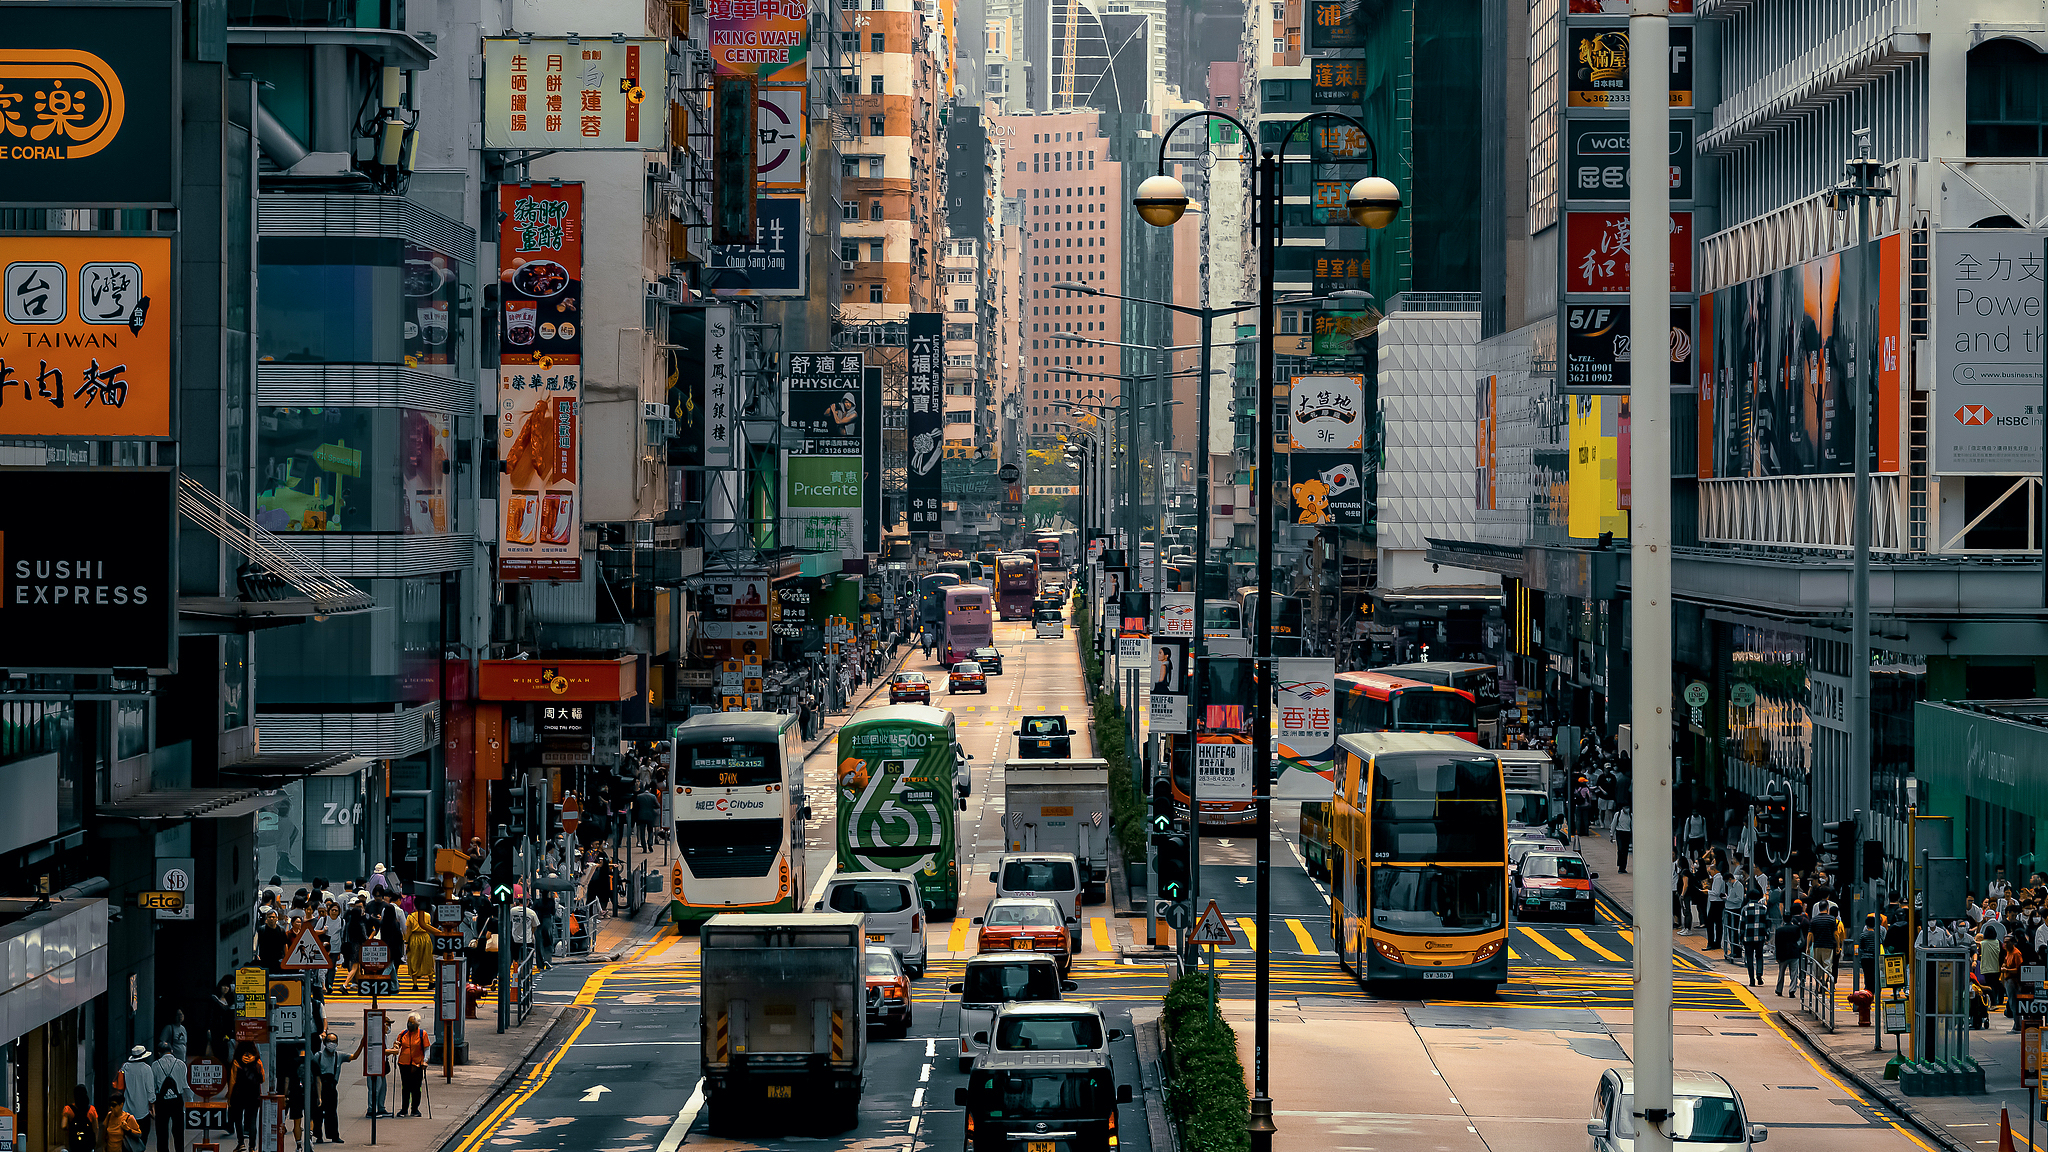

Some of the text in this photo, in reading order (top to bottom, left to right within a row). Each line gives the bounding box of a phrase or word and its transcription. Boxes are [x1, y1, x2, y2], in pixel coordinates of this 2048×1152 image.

[713, 30, 801, 46] KING WAH
[725, 48, 789, 63] CENTRE
[1593, 79, 1624, 88] 日本料理
[511, 54, 528, 132] 生晒臘腸
[11, 146, 65, 160] CORAL
[726, 255, 785, 270] Chow Sang Sang
[17, 268, 131, 319] 台灣
[133, 307, 144, 327] 台北
[1569, 309, 1610, 329] 5/F
[22, 333, 117, 348] TAIWAN
[1954, 325, 2010, 353] and
[790, 355, 860, 375] 舒適堡
[1568, 364, 1612, 372] 3621 0901
[911, 334, 931, 414] 六福珠寶
[1568, 374, 1612, 382] 3621 0902
[790, 378, 860, 389] PHYSICAL
[711, 343, 727, 441] 老鳳祥銀樓
[1996, 416, 2029, 426] HSBC
[1317, 429, 1335, 443] 3/F
[829, 471, 858, 484] 實惠
[794, 482, 858, 496] Pricerite
[16, 560, 103, 579] SUSHI
[16, 585, 148, 605] EXPRESS
[1166, 618, 1193, 632] 香港
[544, 707, 582, 719] 周大福
[1282, 707, 1330, 729] 香港
[1199, 746, 1236, 759] HKIFF48
[719, 772, 738, 785] 970X
[729, 800, 764, 809] Citybus
[321, 803, 362, 825] Zoff
[437, 938, 462, 949] S13
[360, 982, 389, 995] S12
[280, 1010, 297, 1019] hrs
[2018, 1001, 2047, 1014] N66
[188, 1110, 222, 1126] S11
